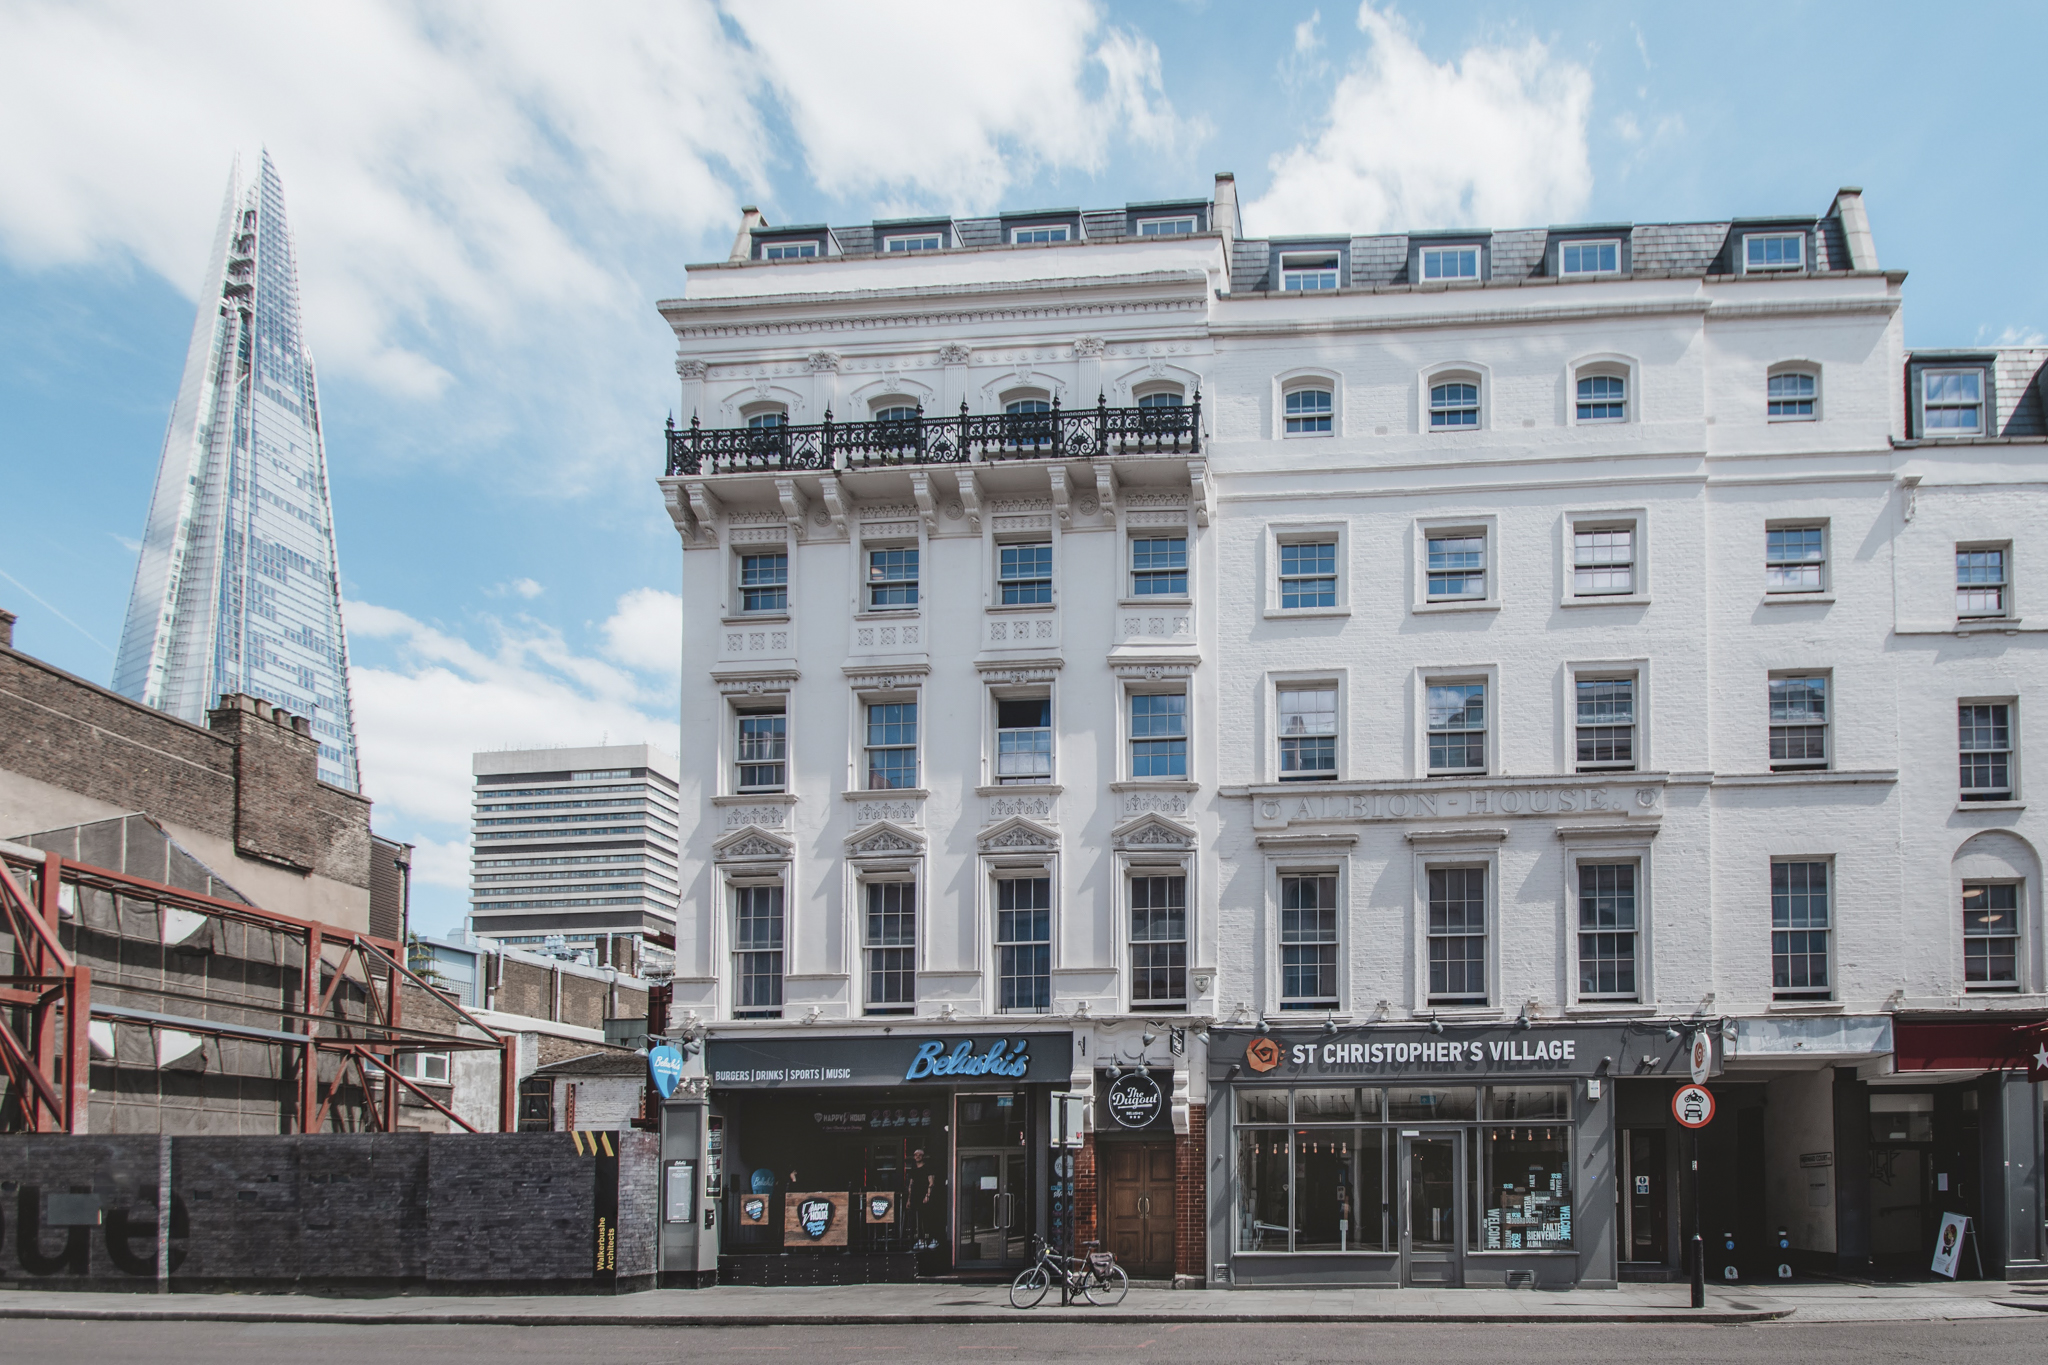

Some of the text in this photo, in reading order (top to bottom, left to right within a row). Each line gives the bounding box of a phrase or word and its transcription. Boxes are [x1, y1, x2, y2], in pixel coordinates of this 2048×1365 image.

[906, 1039, 1029, 1080] Belushi's
[1293, 1044, 1317, 1064] ST
[1488, 1040, 1576, 1061] VILLAGE
[715, 1068, 851, 1081] BURGERS DRINKS SPORTS MUSIC
[1112, 1092, 1158, 1109] Dugout
[1127, 1087, 1144, 1098] The
[1488, 1208, 1500, 1249] WELCOME
[1526, 1230, 1561, 1241] BIENVENUE
[1560, 1205, 1572, 1241] WELCOME
[597, 1216, 606, 1271] Walkerbushe
[606, 1227, 615, 1271] Architects
